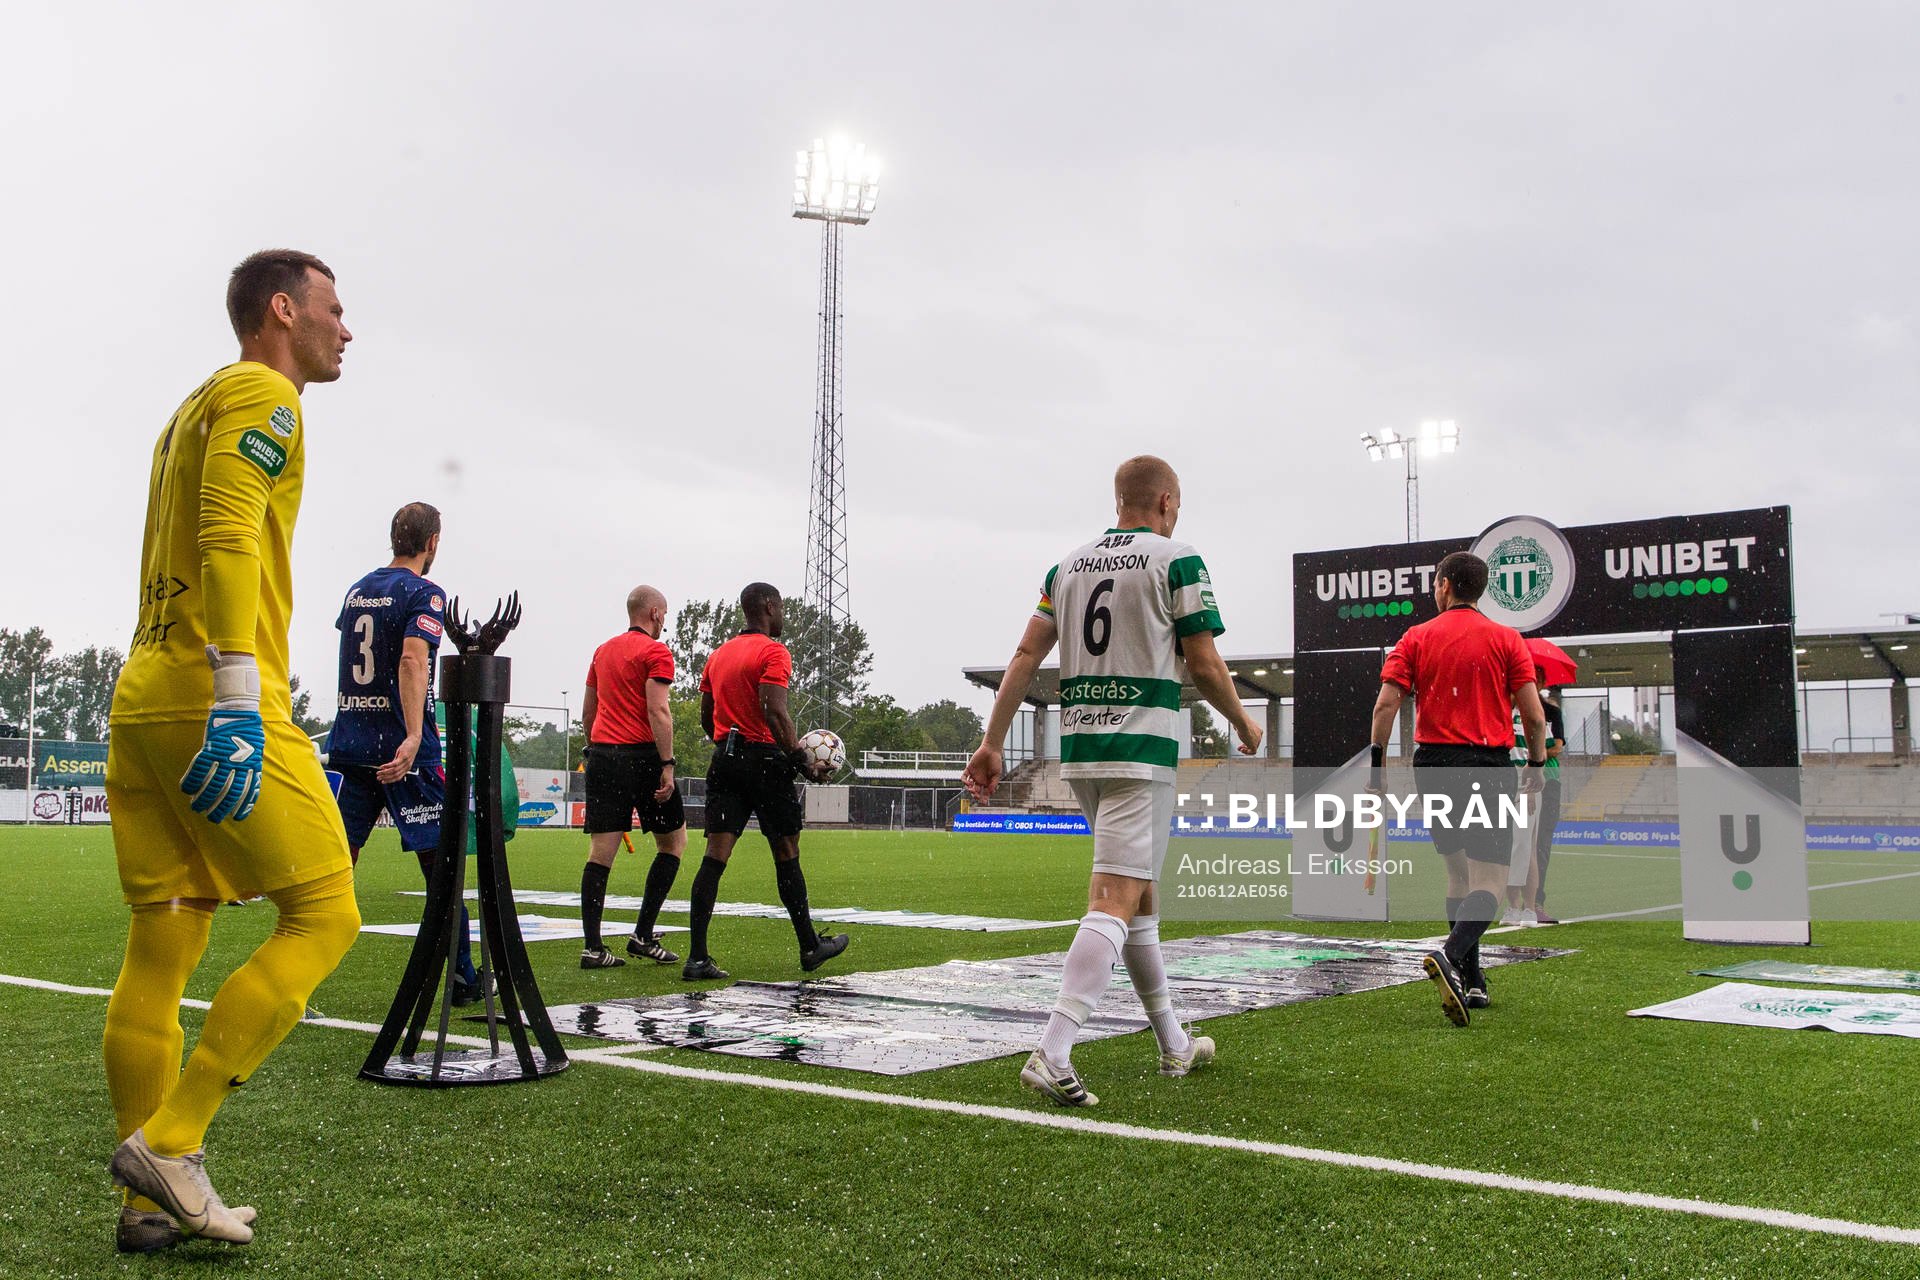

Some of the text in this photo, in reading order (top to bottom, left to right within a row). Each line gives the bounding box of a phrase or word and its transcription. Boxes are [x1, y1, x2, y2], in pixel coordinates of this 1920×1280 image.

[246, 435, 283, 466] UNIBET
[1095, 534, 1135, 549] ABB
[1068, 554, 1150, 575] JOHANSSON
[1505, 555, 1531, 564] VSK
[1605, 536, 1757, 580] UNIBET
[1316, 564, 1436, 602] UNIBET
[1083, 578, 1115, 657] 6
[352, 614, 375, 685] 3
[400, 802, 444, 816] Smålands
[953, 821, 965, 829] Nya
[965, 821, 990, 829] bostäder
[1015, 822, 1033, 830] OBOS
[1034, 822, 1047, 830] Nya
[1047, 822, 1073, 830] bostäder
[1387, 828, 1412, 837] OBOS
[1583, 831, 1601, 839] från
[1620, 832, 1648, 841] OBOS
[1651, 833, 1669, 842] Nya
[1805, 834, 1850, 844] bostäder
[1850, 835, 1870, 844] från
